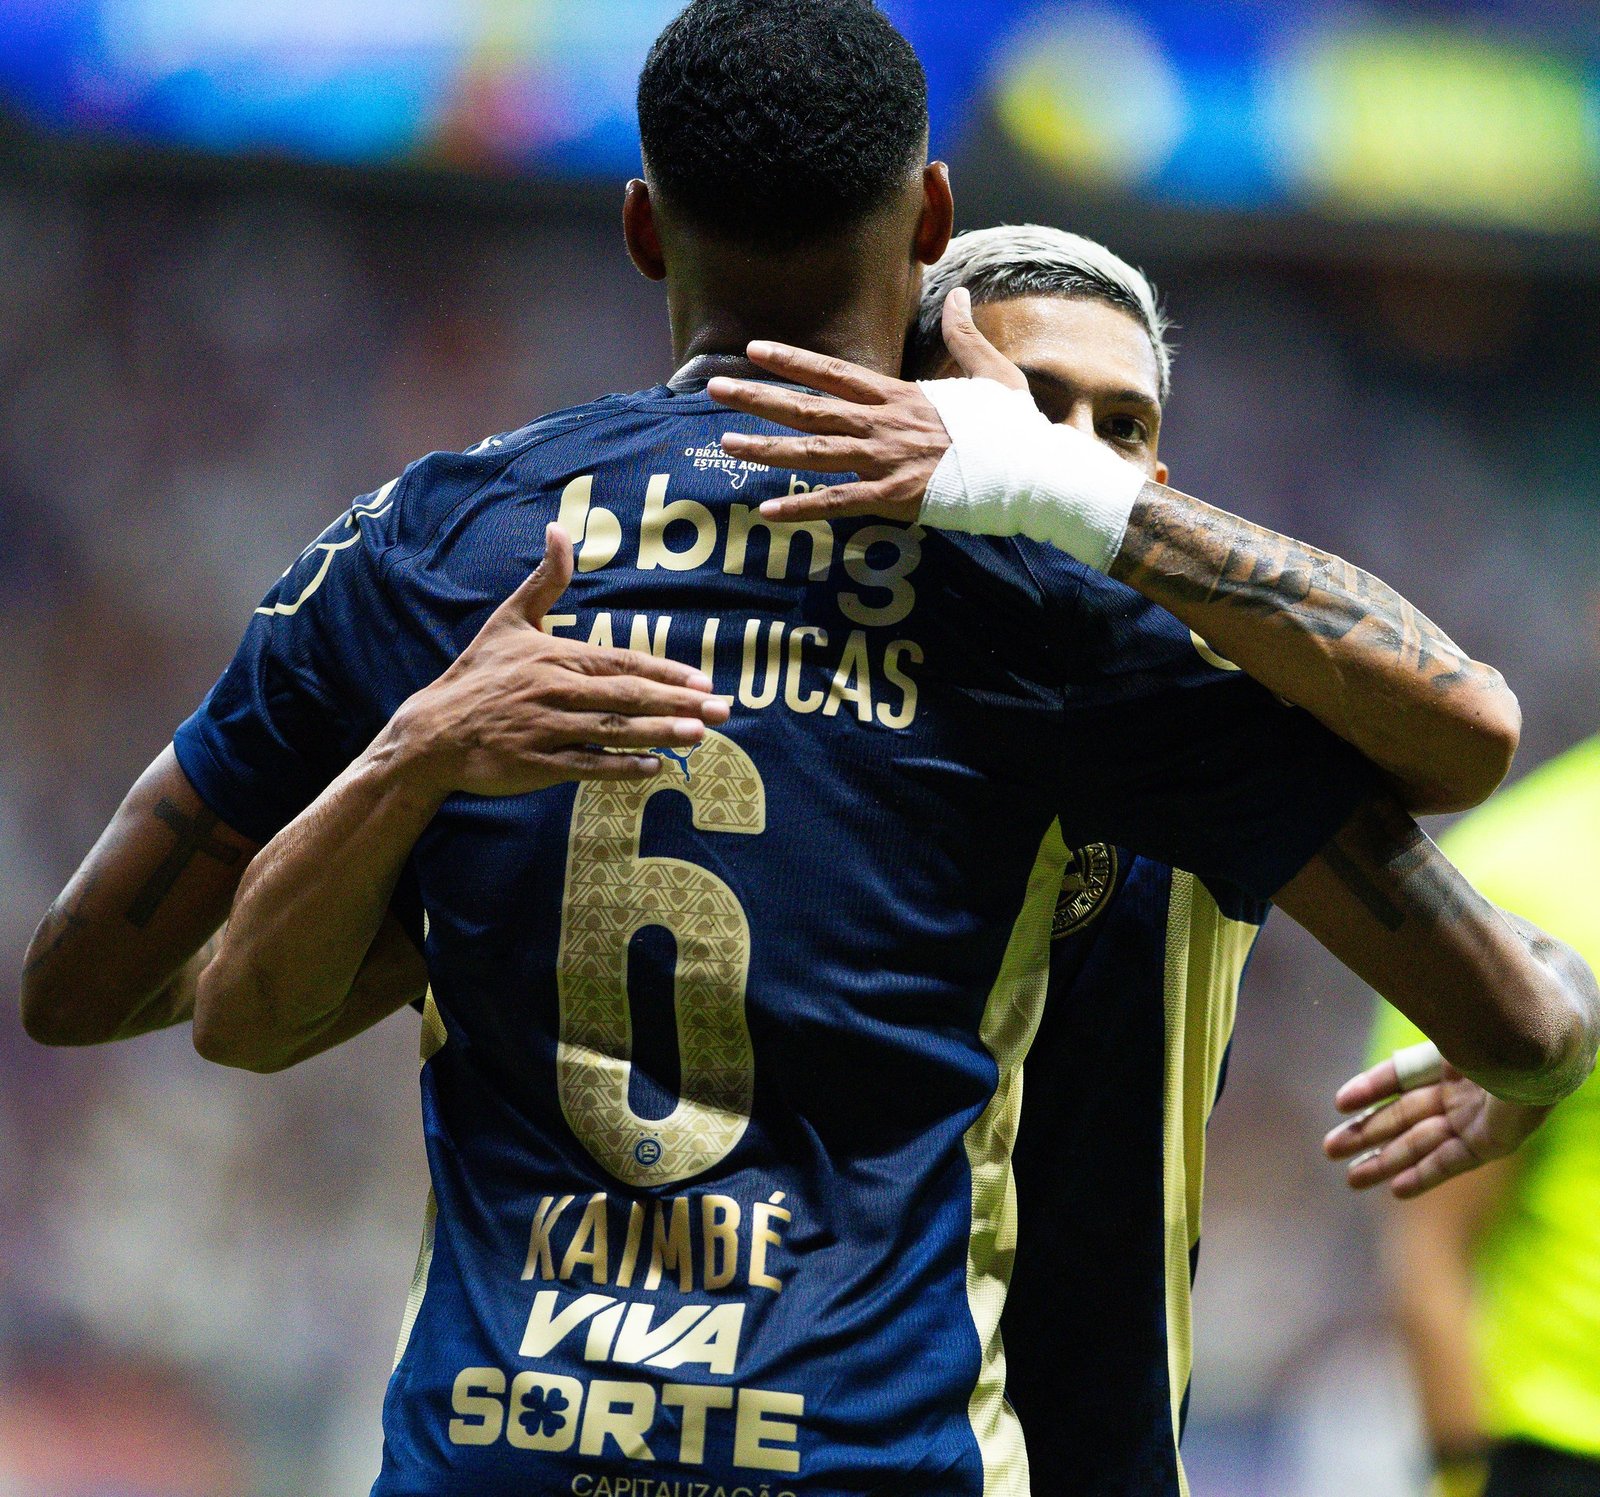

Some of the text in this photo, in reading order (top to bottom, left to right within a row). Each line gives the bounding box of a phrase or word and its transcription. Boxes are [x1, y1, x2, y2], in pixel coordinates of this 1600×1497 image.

[684, 447, 735, 459] O BRAS
[692, 458, 738, 469] ESTEVE
[636, 473, 928, 627] bmg
[699, 617, 925, 730] LUCAS
[556, 726, 766, 1187] 6
[520, 1190, 792, 1294] KAIMBÉ
[518, 1290, 746, 1375] VIVA
[448, 1366, 805, 1473] SORTE
[570, 1473, 799, 1497] CAPITALIZ
